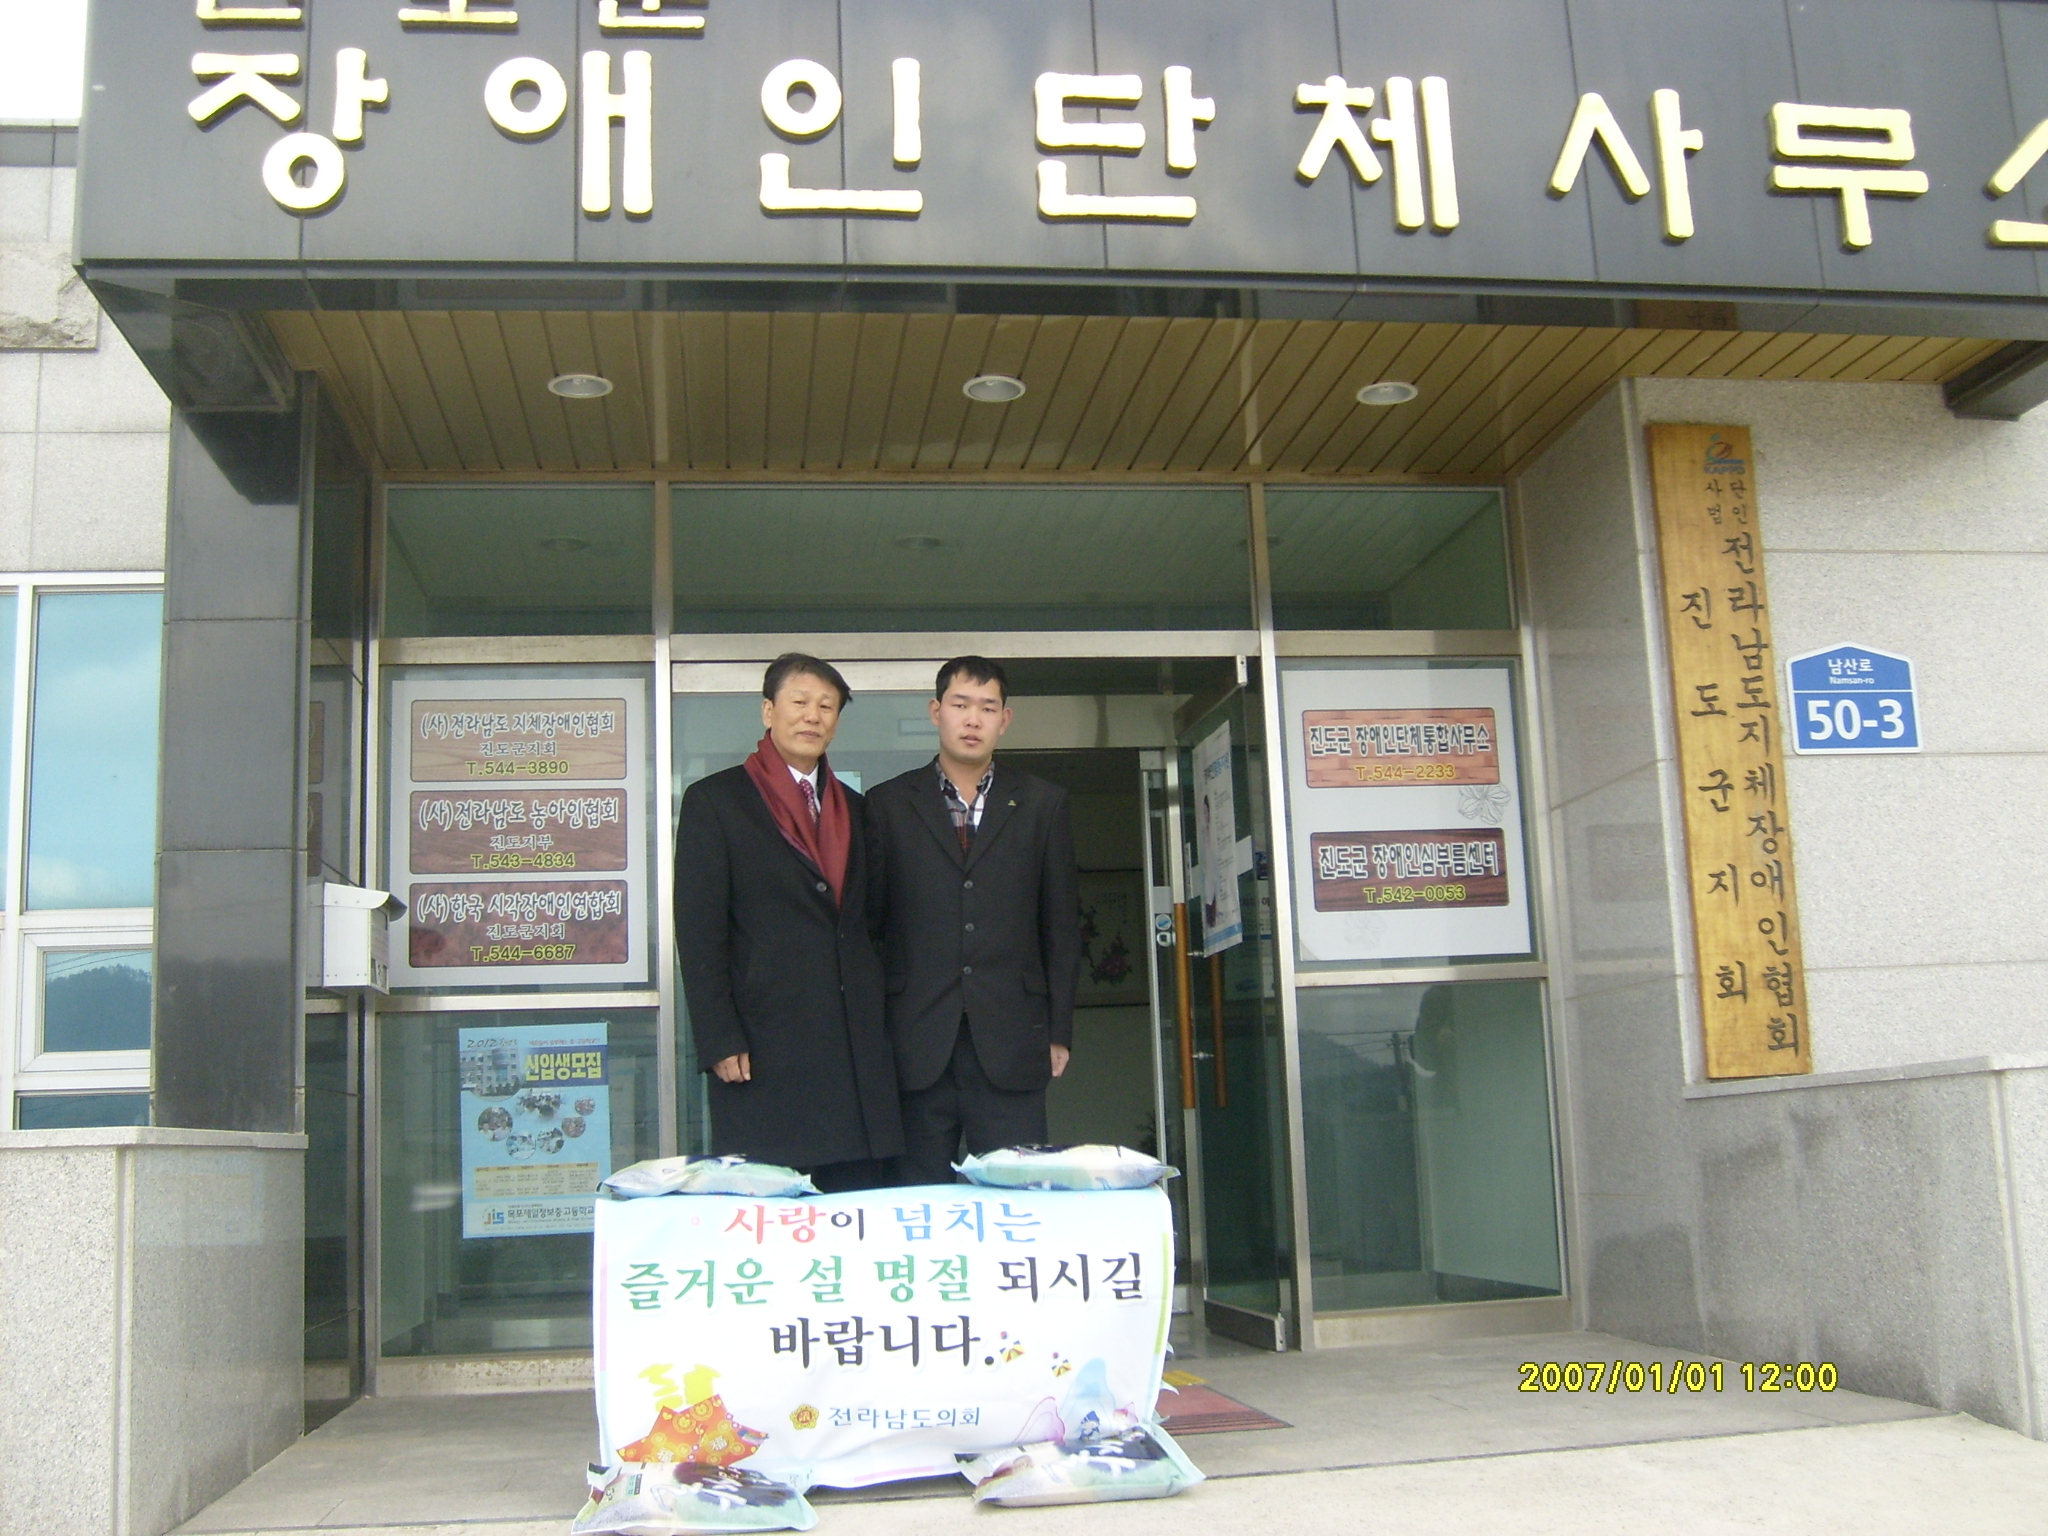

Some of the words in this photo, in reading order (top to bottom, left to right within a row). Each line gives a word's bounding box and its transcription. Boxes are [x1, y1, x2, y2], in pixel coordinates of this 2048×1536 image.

[1827, 658, 1875, 675] 남산로
[1829, 676, 1875, 685] Namsan-ro
[511, 711, 616, 739] 지체장애인협회
[1806, 698, 1906, 741] 50-3
[479, 741, 558, 756] 진도군지회
[1309, 725, 1352, 756] 진도군
[1355, 722, 1491, 756] 장애인단체통합사무소
[466, 760, 570, 776] T.544-3890
[1355, 764, 1456, 780] T.544-2233
[529, 797, 619, 830] 농아인협회
[490, 835, 554, 851] 진도지부
[470, 853, 576, 870] T.543-4834
[1319, 846, 1368, 879] 진도군
[1372, 842, 1499, 879] 장애인심부름센터
[1364, 884, 1466, 904] T.542-0053
[487, 891, 622, 924] 시각장애인연합회
[486, 924, 566, 940] 진도군지회
[470, 944, 577, 962] T.544-6687
[467, 1039, 499, 1048] 2012
[524, 1052, 602, 1082] 신입생모집
[724, 1204, 865, 1244] 사랑이
[892, 1201, 1041, 1242] 넘치는
[621, 1257, 774, 1310] 즐거운
[799, 1255, 845, 1303] 설
[874, 1254, 971, 1303] 명절
[997, 1252, 1143, 1303] 되시길
[769, 1315, 994, 1369] 바랍니다.
[828, 1407, 980, 1429] 전라남도의회
